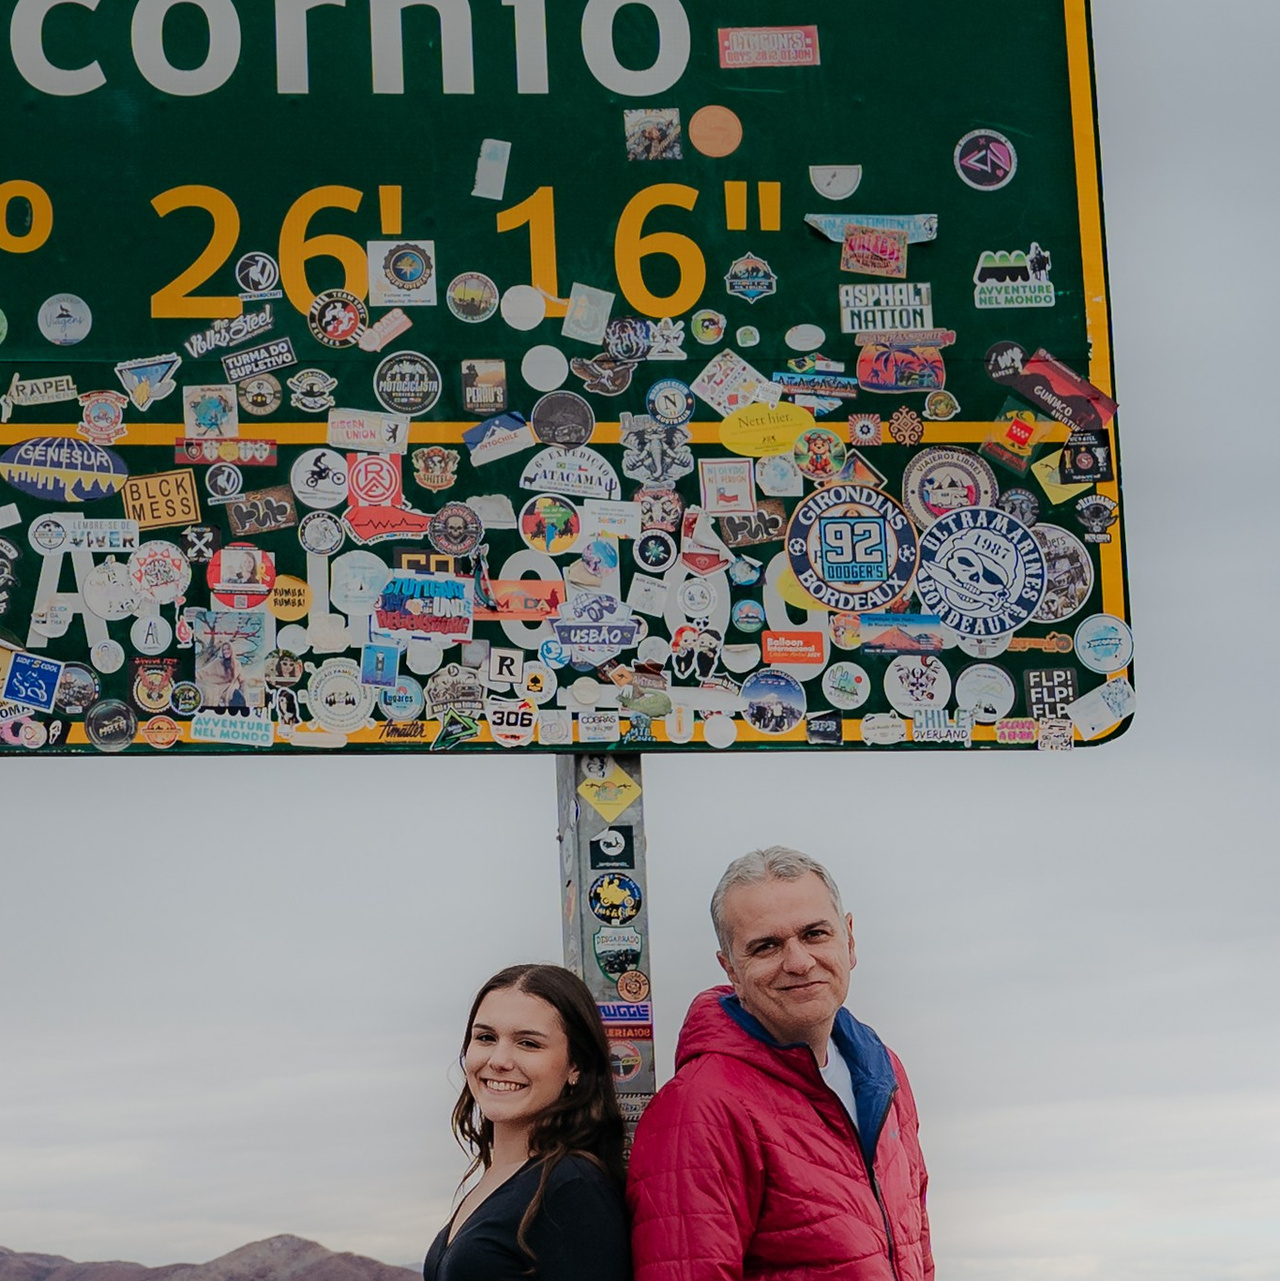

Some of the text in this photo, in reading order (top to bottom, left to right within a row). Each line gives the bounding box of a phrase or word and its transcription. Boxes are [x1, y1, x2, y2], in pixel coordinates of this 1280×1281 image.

[841, 284, 931, 307] ASPHALT
[978, 284, 1052, 295] AVVENTURE
[979, 295, 1053, 306] NEL MONDO
[229, 304, 274, 338] Steel
[850, 307, 925, 331] NATION
[226, 342, 287, 368] TURMA DO
[229, 353, 293, 381] SUPLETIVO
[1032, 384, 1074, 419] GUANACO
[738, 410, 794, 429] Nett hier.
[345, 428, 377, 440] UNION
[21, 444, 109, 468] GENESUR
[548, 448, 610, 478] EXPEDIÇÃO
[916, 453, 982, 476] VIAJEROS LIBRES
[130, 477, 188, 501] BLCK
[539, 469, 603, 487] ATACAMA
[131, 499, 193, 522] MESS
[799, 485, 908, 530] GIRONDINS
[824, 521, 886, 565] 92
[971, 535, 1011, 560] 1987
[923, 508, 1045, 601] ULTRAMARINES
[827, 564, 885, 580] DODGER'S
[799, 569, 908, 612] BORDEAUX
[919, 575, 1025, 636] BORDEAUX
[569, 625, 622, 645] USBÃO
[767, 637, 804, 648] Balloon
[496, 655, 516, 677] R
[1029, 671, 1072, 687] FLP!
[383, 690, 414, 705] Lugares
[1031, 687, 1075, 704] FLP!
[194, 716, 270, 732] AVVENTURE
[491, 710, 533, 728] 306
[914, 709, 967, 728] CHILE
[193, 726, 270, 742] NEL MONDO
[913, 729, 969, 741] OVERLAND
[596, 934, 640, 945] DESGARRADO
